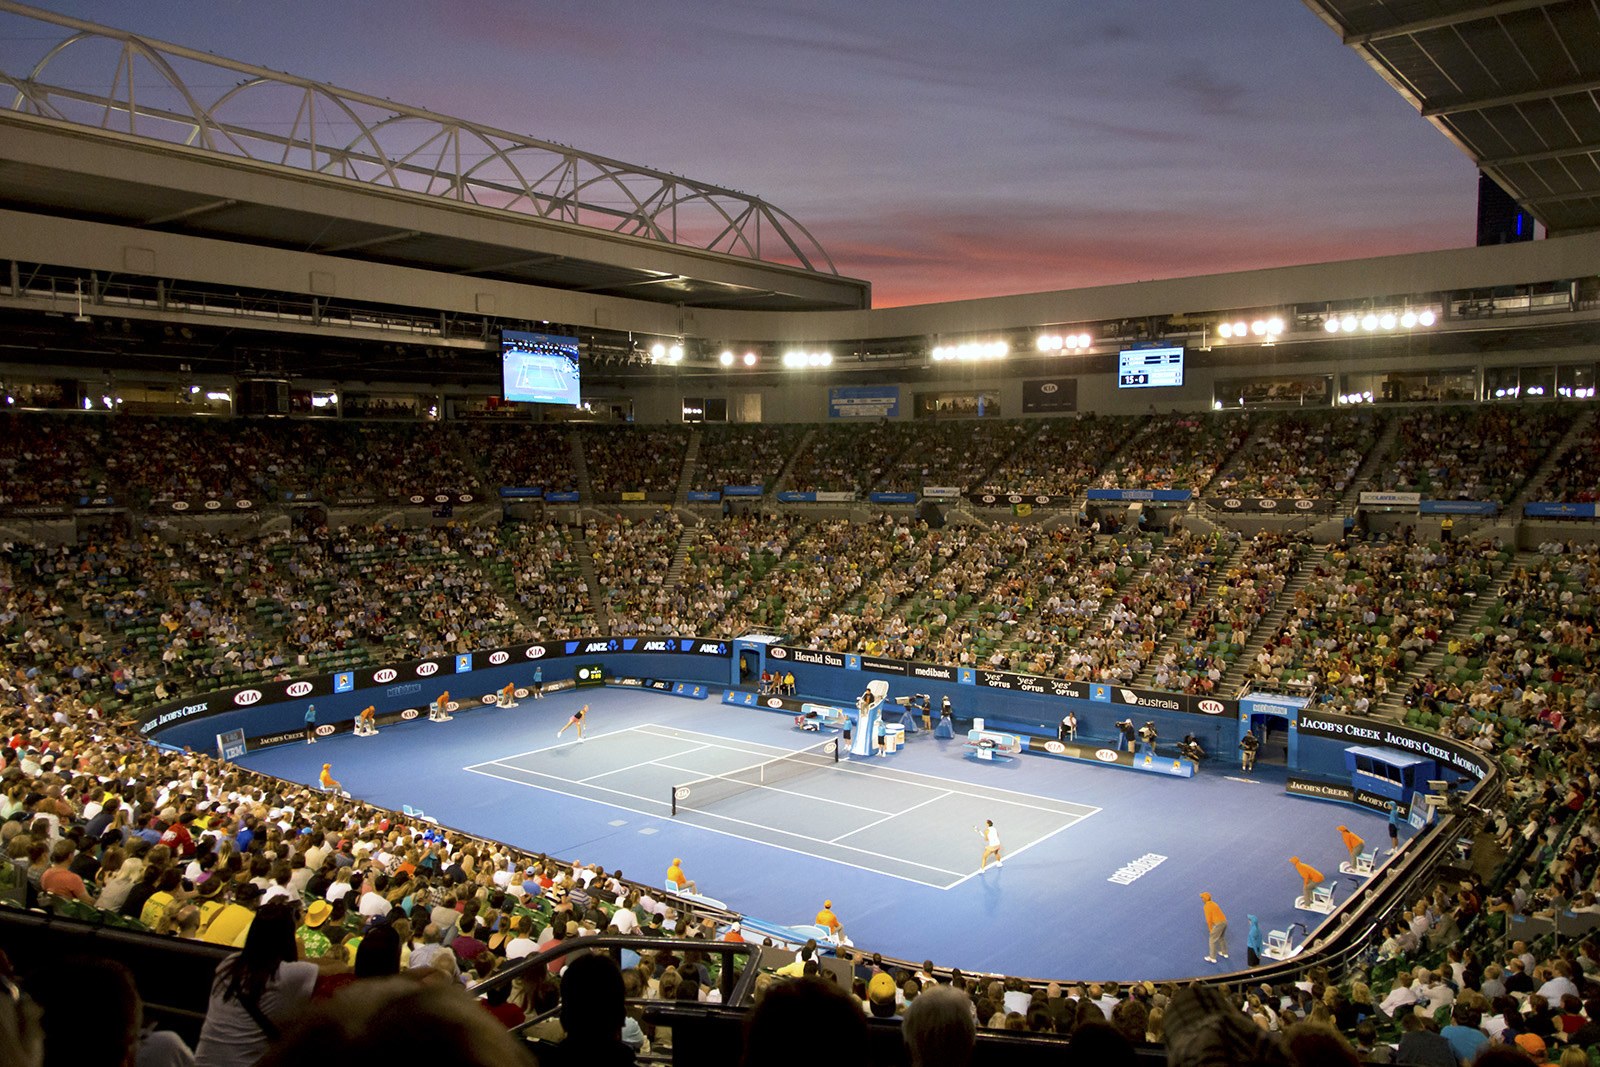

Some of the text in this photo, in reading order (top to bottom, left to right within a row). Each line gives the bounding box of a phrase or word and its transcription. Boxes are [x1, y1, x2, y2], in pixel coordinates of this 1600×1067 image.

[585, 642, 608, 652] ANZ
[643, 641, 666, 651] ANZ
[699, 643, 719, 654] ANZ
[528, 648, 544, 656] KIA
[772, 648, 785, 657] KIA
[490, 653, 507, 662] KIA
[794, 651, 843, 666] Herald Sun
[419, 664, 435, 673] KIA
[915, 667, 951, 679] medibank
[377, 671, 394, 680] KIA
[290, 684, 310, 694] KIA
[988, 680, 1011, 689] OPTUS
[1021, 684, 1044, 693] OPTUS
[238, 692, 258, 703] KIA
[1055, 688, 1079, 698] OPTUS
[1137, 697, 1179, 710] australia
[1201, 702, 1221, 712] KIA
[159, 709, 183, 725] JACOB'S
[182, 702, 208, 717] CREEK
[318, 726, 333, 734] KIA
[260, 732, 305, 745] JACOB'S CREEK
[1047, 743, 1063, 752] KIA
[1300, 717, 1343, 733] JACOB'S
[1345, 724, 1381, 740] CREEK
[1384, 732, 1421, 751] JACOB'S
[1422, 742, 1450, 761] CREEK
[1452, 753, 1476, 774] JACOB'S
[225, 745, 245, 759] IBM
[1099, 751, 1115, 759] KIA
[1290, 781, 1349, 798] JACOB'S CREEK
[1358, 793, 1383, 807] JACOB'S
